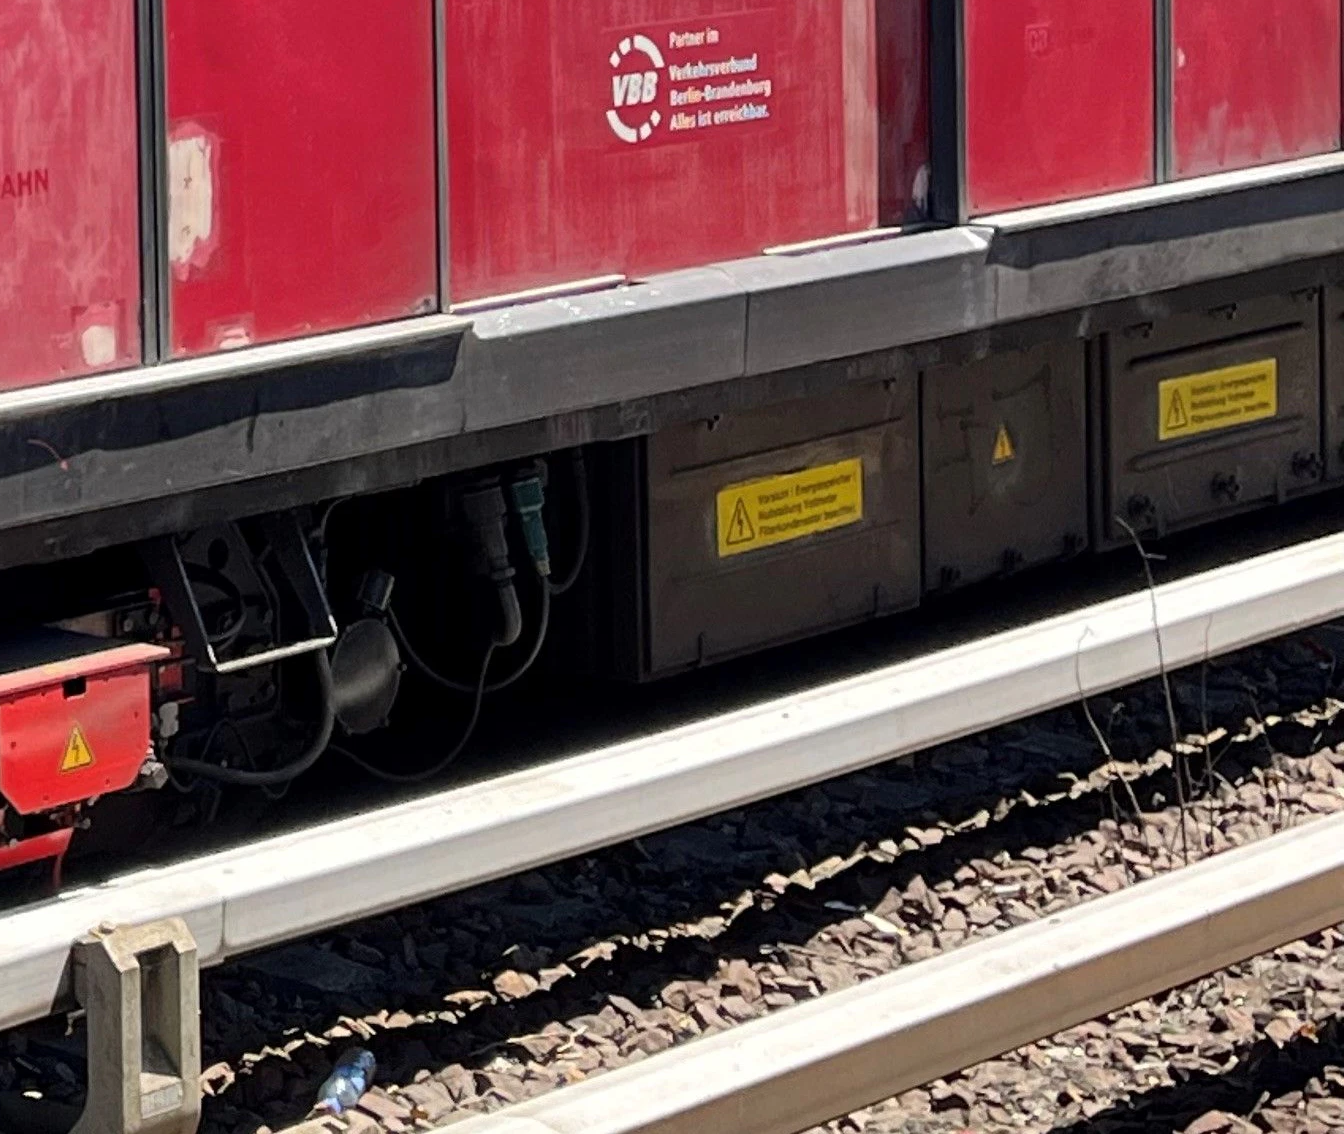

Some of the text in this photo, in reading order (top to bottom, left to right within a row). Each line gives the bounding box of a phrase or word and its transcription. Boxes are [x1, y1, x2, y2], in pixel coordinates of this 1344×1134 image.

[611, 70, 659, 108] VBB
[669, 78, 772, 107] Berlin-Brandenburg
[669, 112, 696, 132] Alles
